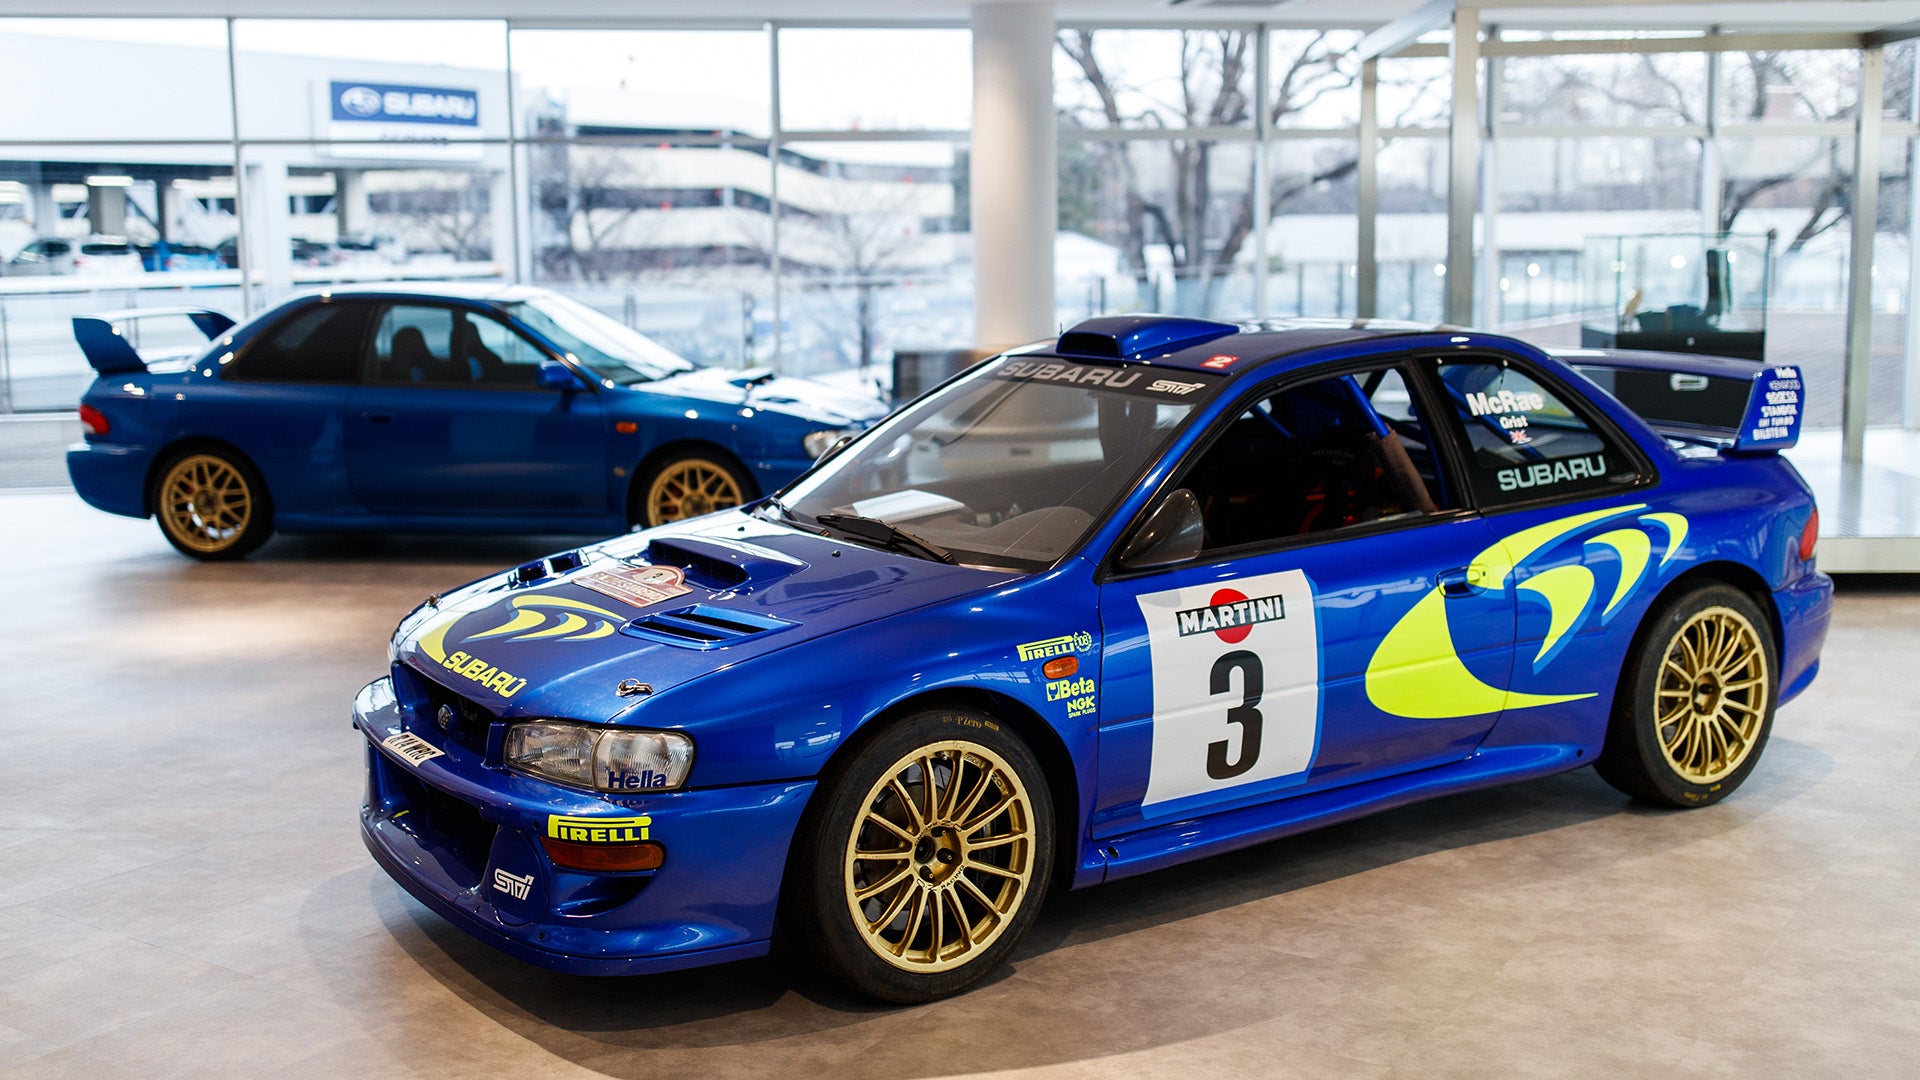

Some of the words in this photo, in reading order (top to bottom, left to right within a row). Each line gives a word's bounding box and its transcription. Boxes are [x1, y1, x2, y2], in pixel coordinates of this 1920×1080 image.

[998, 361, 1142, 388] SUBARU
[1207, 356, 1234, 368] 2
[1465, 390, 1544, 417] McRae
[1500, 415, 1529, 430] Grist
[1497, 455, 1606, 491] SUBARU
[1182, 597, 1283, 634] MARTINI
[1016, 635, 1075, 662] PIRELLI
[444, 651, 528, 698] SUBARU
[1059, 677, 1096, 700] Beta
[1067, 695, 1096, 713] NGK
[1082, 706, 1097, 716] PLUGS
[1206, 650, 1264, 780] 3
[607, 770, 667, 788] Hella
[548, 814, 652, 842] PIRELLI
